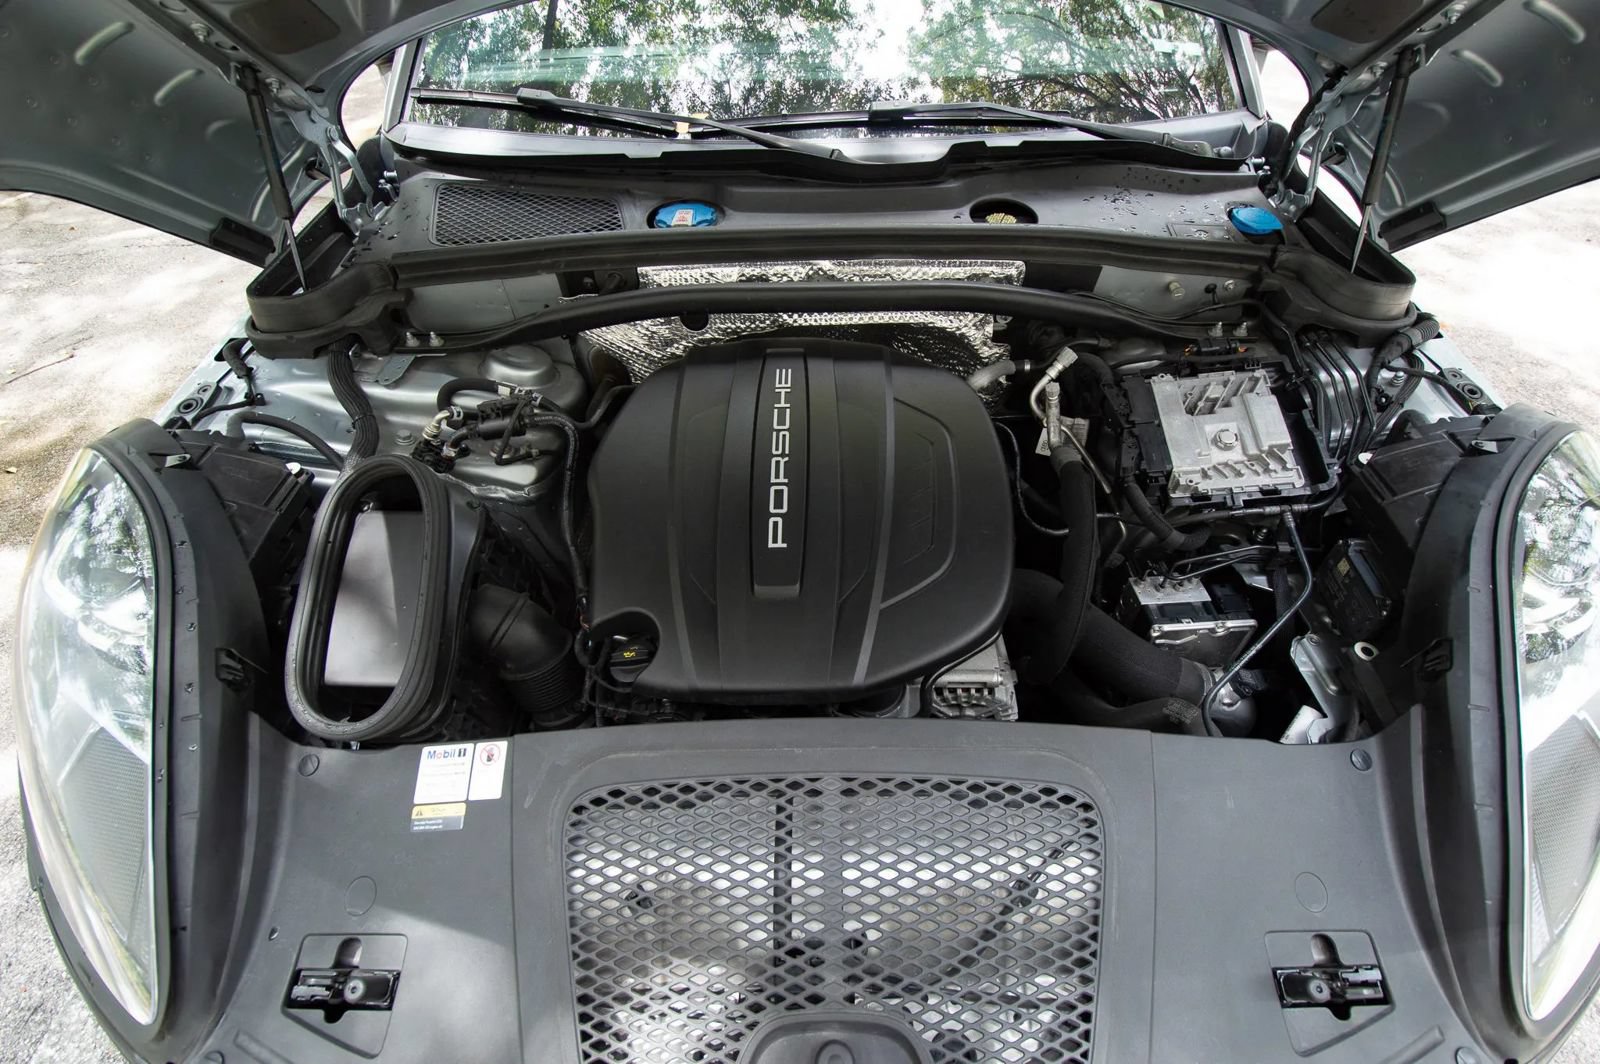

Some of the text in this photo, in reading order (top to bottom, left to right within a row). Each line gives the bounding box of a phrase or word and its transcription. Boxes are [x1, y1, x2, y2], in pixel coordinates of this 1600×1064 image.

[768, 368, 792, 549] PORSCHE
[427, 748, 467, 760] Mobil 1
